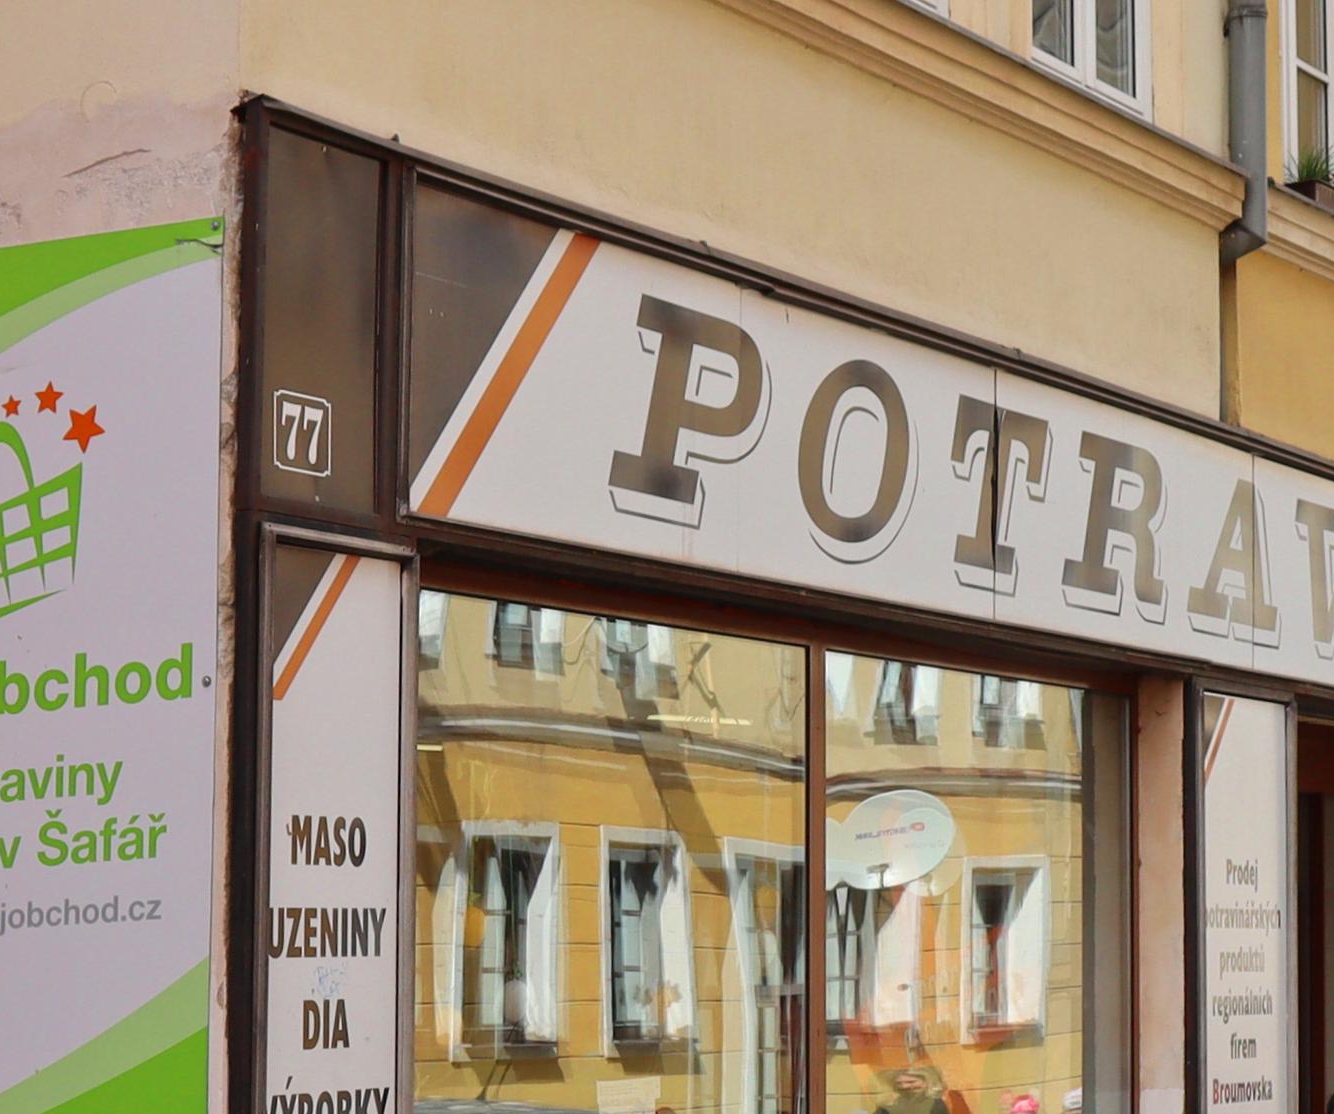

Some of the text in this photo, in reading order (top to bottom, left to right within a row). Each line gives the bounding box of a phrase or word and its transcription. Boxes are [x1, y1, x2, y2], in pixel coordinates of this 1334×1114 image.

[281, 400, 324, 465] 77
[36, 808, 167, 867] Šafář
[290, 814, 367, 867] MASO
[1226, 858, 1259, 893] Prodej
[267, 907, 387, 959] UZENINY
[1207, 900, 1282, 937] otravinářských
[1219, 943, 1266, 981] produktů
[302, 999, 350, 1050] DIA
[1212, 989, 1273, 1024] regionálních
[1230, 1034, 1257, 1060] firem
[1213, 1077, 1273, 1105] Broumovska
